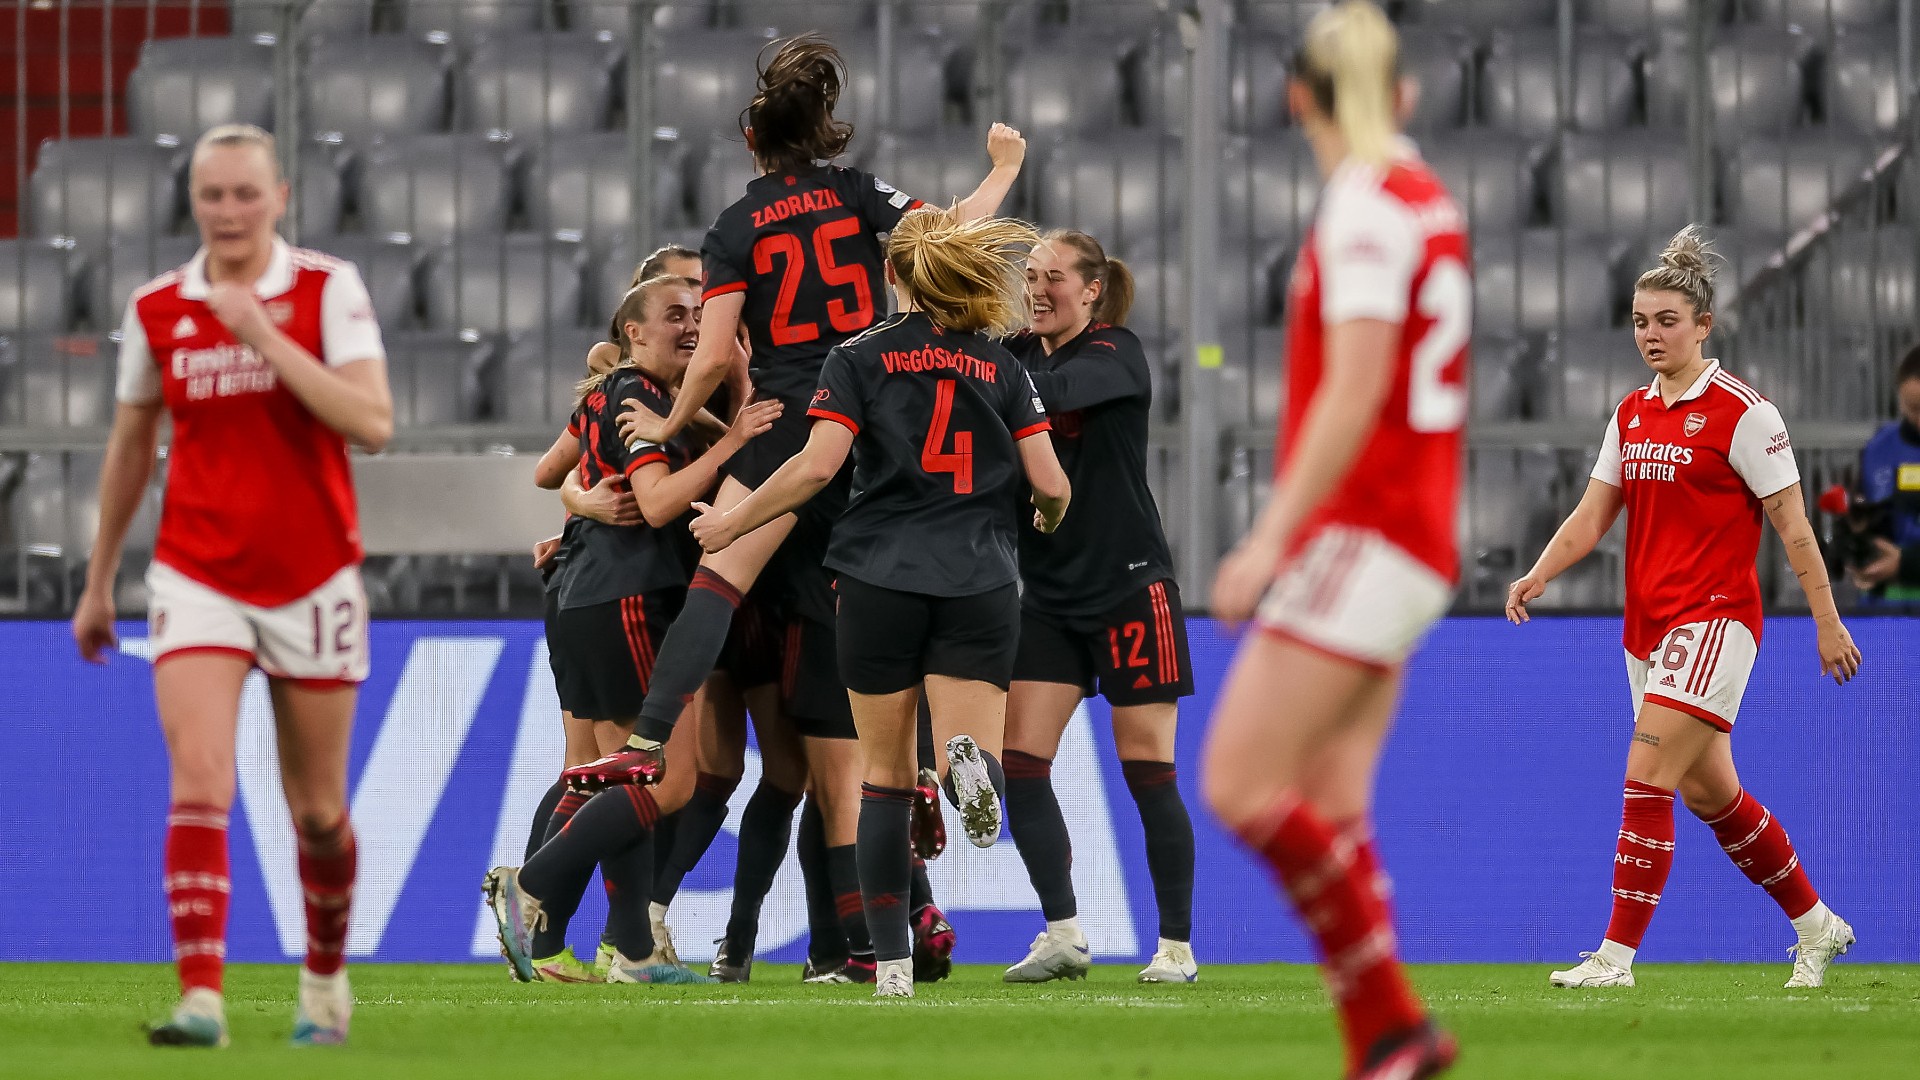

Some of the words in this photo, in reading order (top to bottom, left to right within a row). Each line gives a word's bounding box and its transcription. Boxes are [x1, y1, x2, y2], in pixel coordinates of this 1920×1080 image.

[751, 188, 843, 229] ZADRAZIL
[752, 216, 875, 346] 25
[881, 343, 997, 384] VIGGÓSDÓTTIR
[921, 379, 973, 494] 4
[1621, 438, 1694, 465] Emirates
[1770, 431, 1787, 443] VISIT
[1625, 462, 1638, 480] FLY
[1640, 462, 1676, 483] BETTER
[311, 601, 354, 657] 12
[1108, 621, 1150, 669] 12
[1614, 852, 1652, 869] AFC
